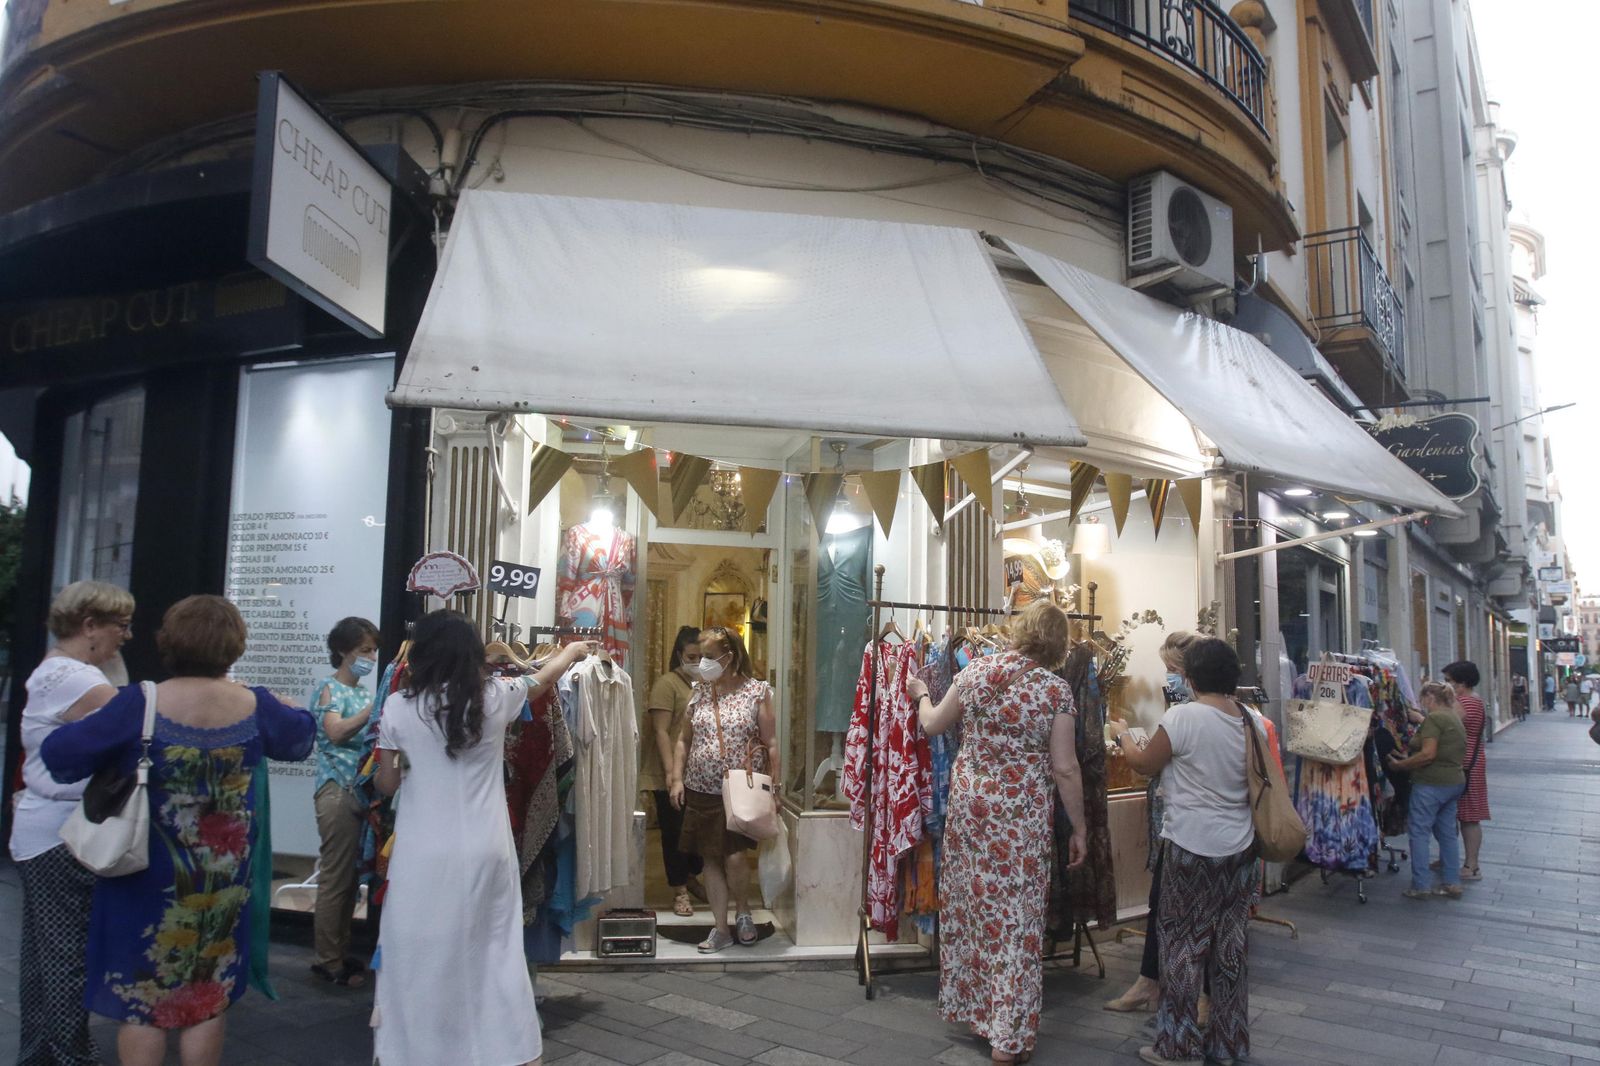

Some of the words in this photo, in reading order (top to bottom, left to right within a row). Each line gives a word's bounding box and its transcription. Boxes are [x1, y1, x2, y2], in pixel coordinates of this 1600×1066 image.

[278, 118, 348, 199] CHEAP
[10, 299, 118, 353] CHEAP
[1386, 433, 1464, 458] Gardenias
[232, 512, 263, 521] LISTADO
[265, 511, 295, 520] PRECIOS
[231, 522, 256, 531] COLOR
[231, 533, 255, 541] COLOR
[256, 532, 270, 541] SIN
[271, 532, 313, 541] AMONIACO
[231, 544, 255, 552] COLOR
[257, 544, 292, 552] PREMIUM
[230, 555, 261, 563] MECHAS
[229, 566, 260, 574] MECHAS
[260, 566, 274, 574] SIN
[275, 565, 318, 574] AMONIACO
[228, 577, 259, 585] MECHAS
[260, 577, 297, 585] PREMIUM
[490, 565, 538, 589] 9,99
[227, 588, 255, 596] PEINAR
[251, 610, 296, 619] CABALLERO
[253, 622, 297, 630] CABALLERO
[281, 633, 319, 642] KERATINA
[280, 644, 323, 653] ANTICAIDA
[243, 655, 278, 663] AMIENTO
[279, 655, 305, 664] BOTOX
[257, 666, 296, 675] KERATINA
[1320, 686, 1336, 699] 20€
